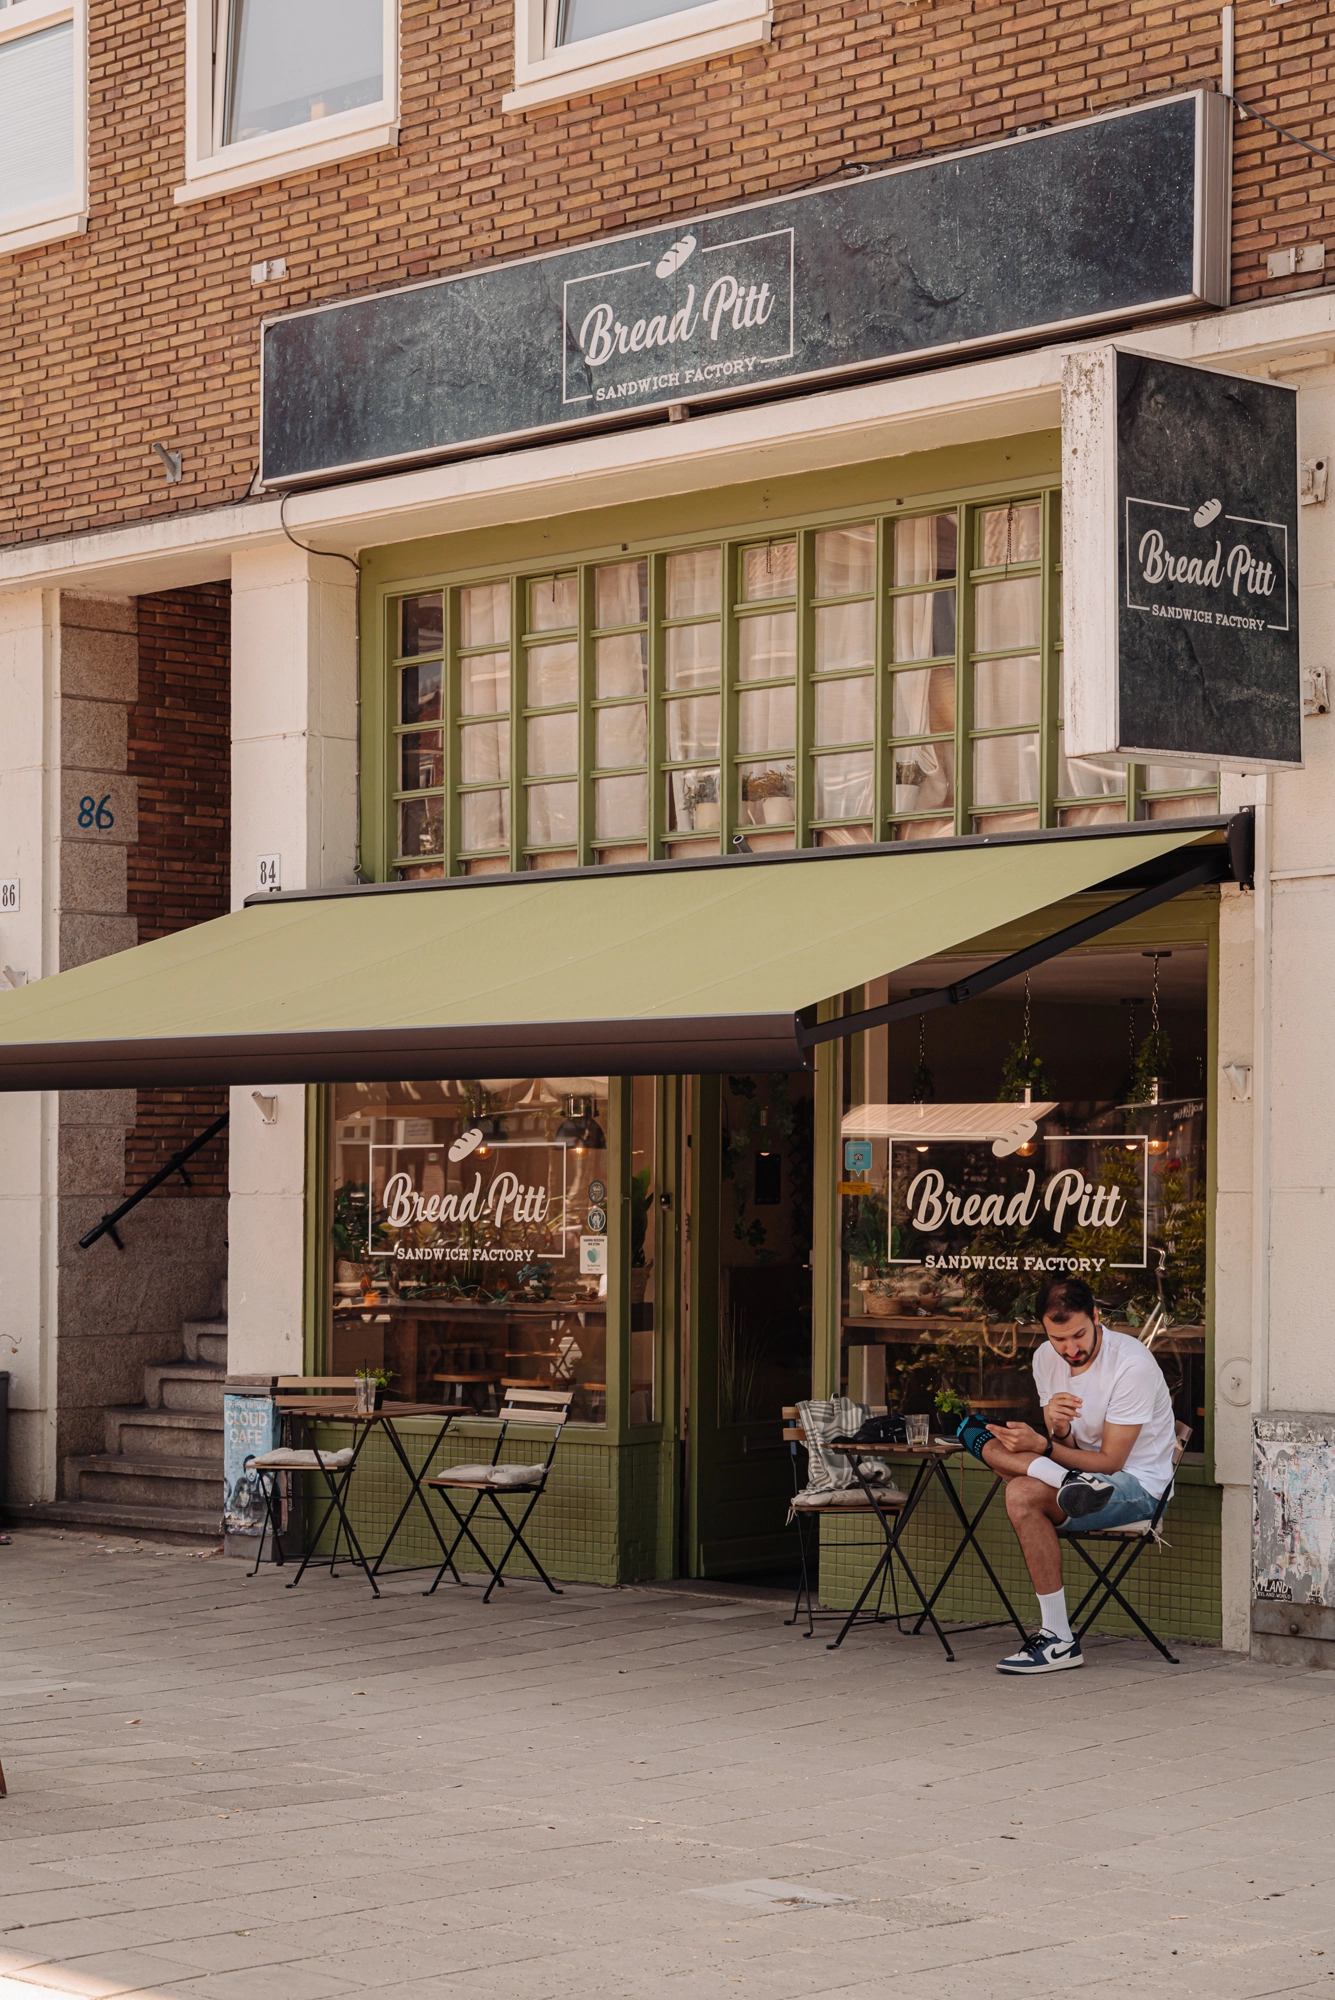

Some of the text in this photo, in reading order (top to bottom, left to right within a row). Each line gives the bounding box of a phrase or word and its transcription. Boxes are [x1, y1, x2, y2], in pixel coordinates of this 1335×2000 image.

[579, 275, 776, 366] Bread Pitt
[596, 356, 757, 401] SANDWICH FACTORY
[1138, 529, 1277, 597] Bread Pitt
[1151, 604, 1265, 631] SANDWICH FACTORY
[77, 794, 115, 830] 86
[260, 860, 276, 885] 84
[2, 884, 16, 907] 86
[383, 1171, 551, 1229] Bread Pitt
[906, 1168, 1127, 1234] Bread Pitt
[397, 1247, 535, 1262] SANDWICH FACTORY
[925, 1255, 1106, 1272] SANDWICH FACTORY
[225, 1410, 268, 1427] CLOUD
[230, 1428, 263, 1445] CAFE
